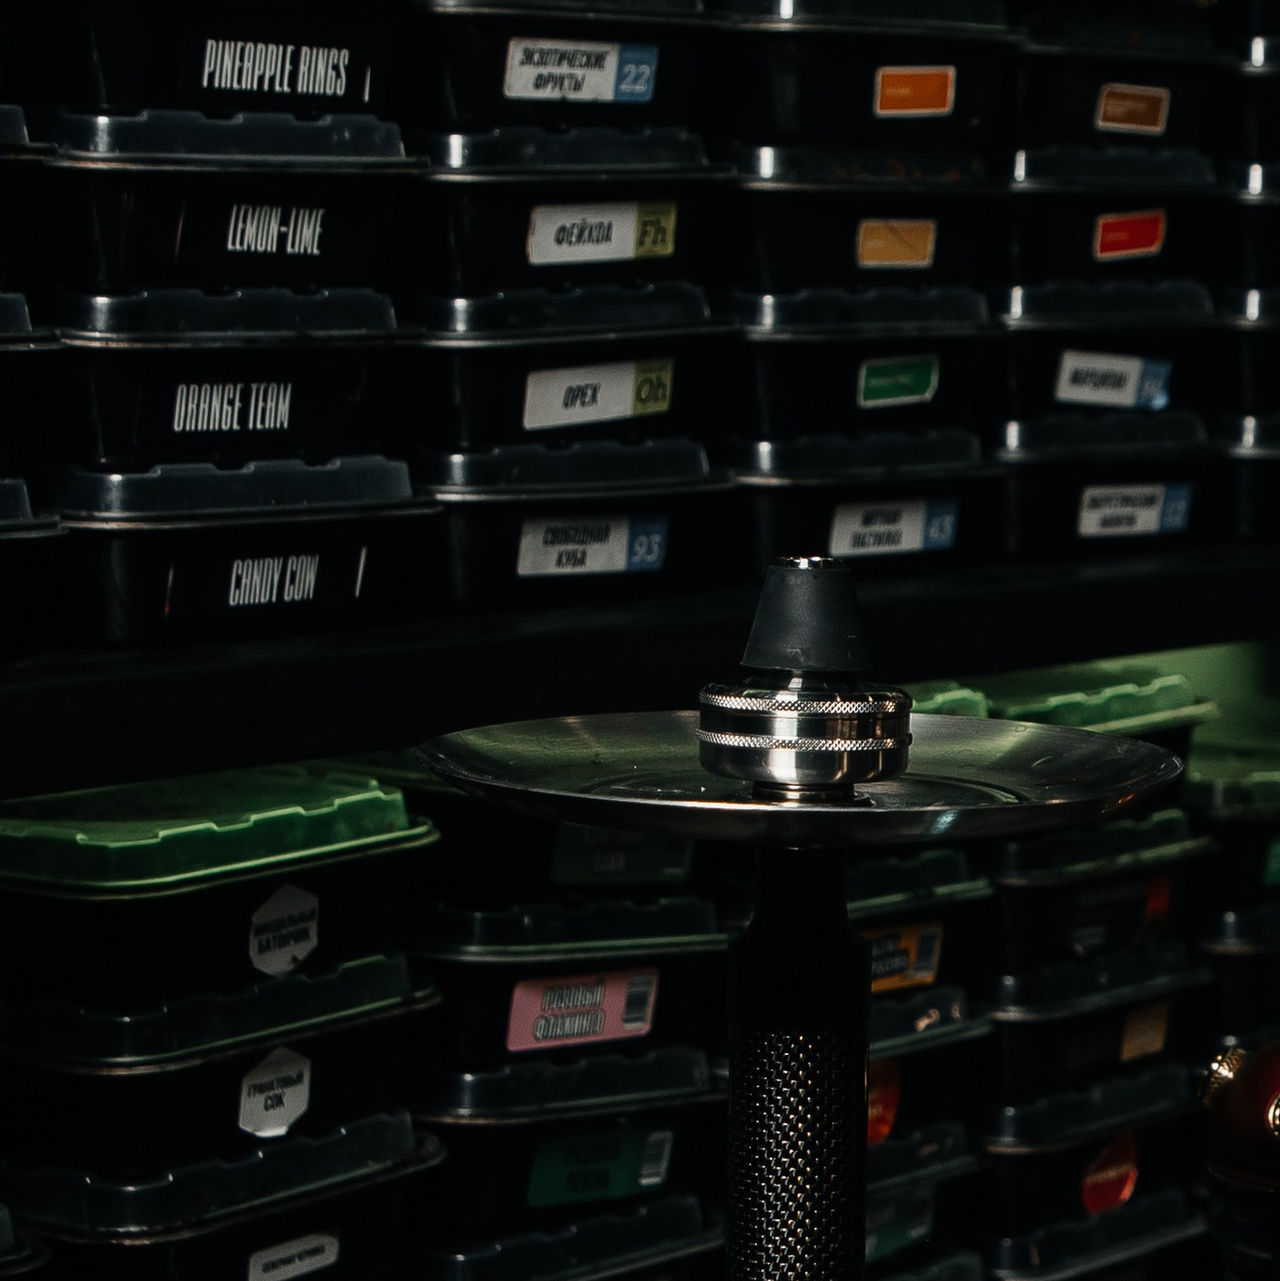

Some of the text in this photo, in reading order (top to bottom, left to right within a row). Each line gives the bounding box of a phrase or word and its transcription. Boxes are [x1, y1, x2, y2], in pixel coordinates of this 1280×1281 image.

[202, 38, 350, 98] PINEAPPLE RINGS
[619, 64, 650, 94] 22
[226, 204, 326, 257] LEMON-LIME
[173, 381, 292, 433] ORANGE TEAM
[563, 381, 602, 410] ОРЕХ
[228, 553, 320, 608] CANDY COW
[263, 1092, 287, 1113] СОК
